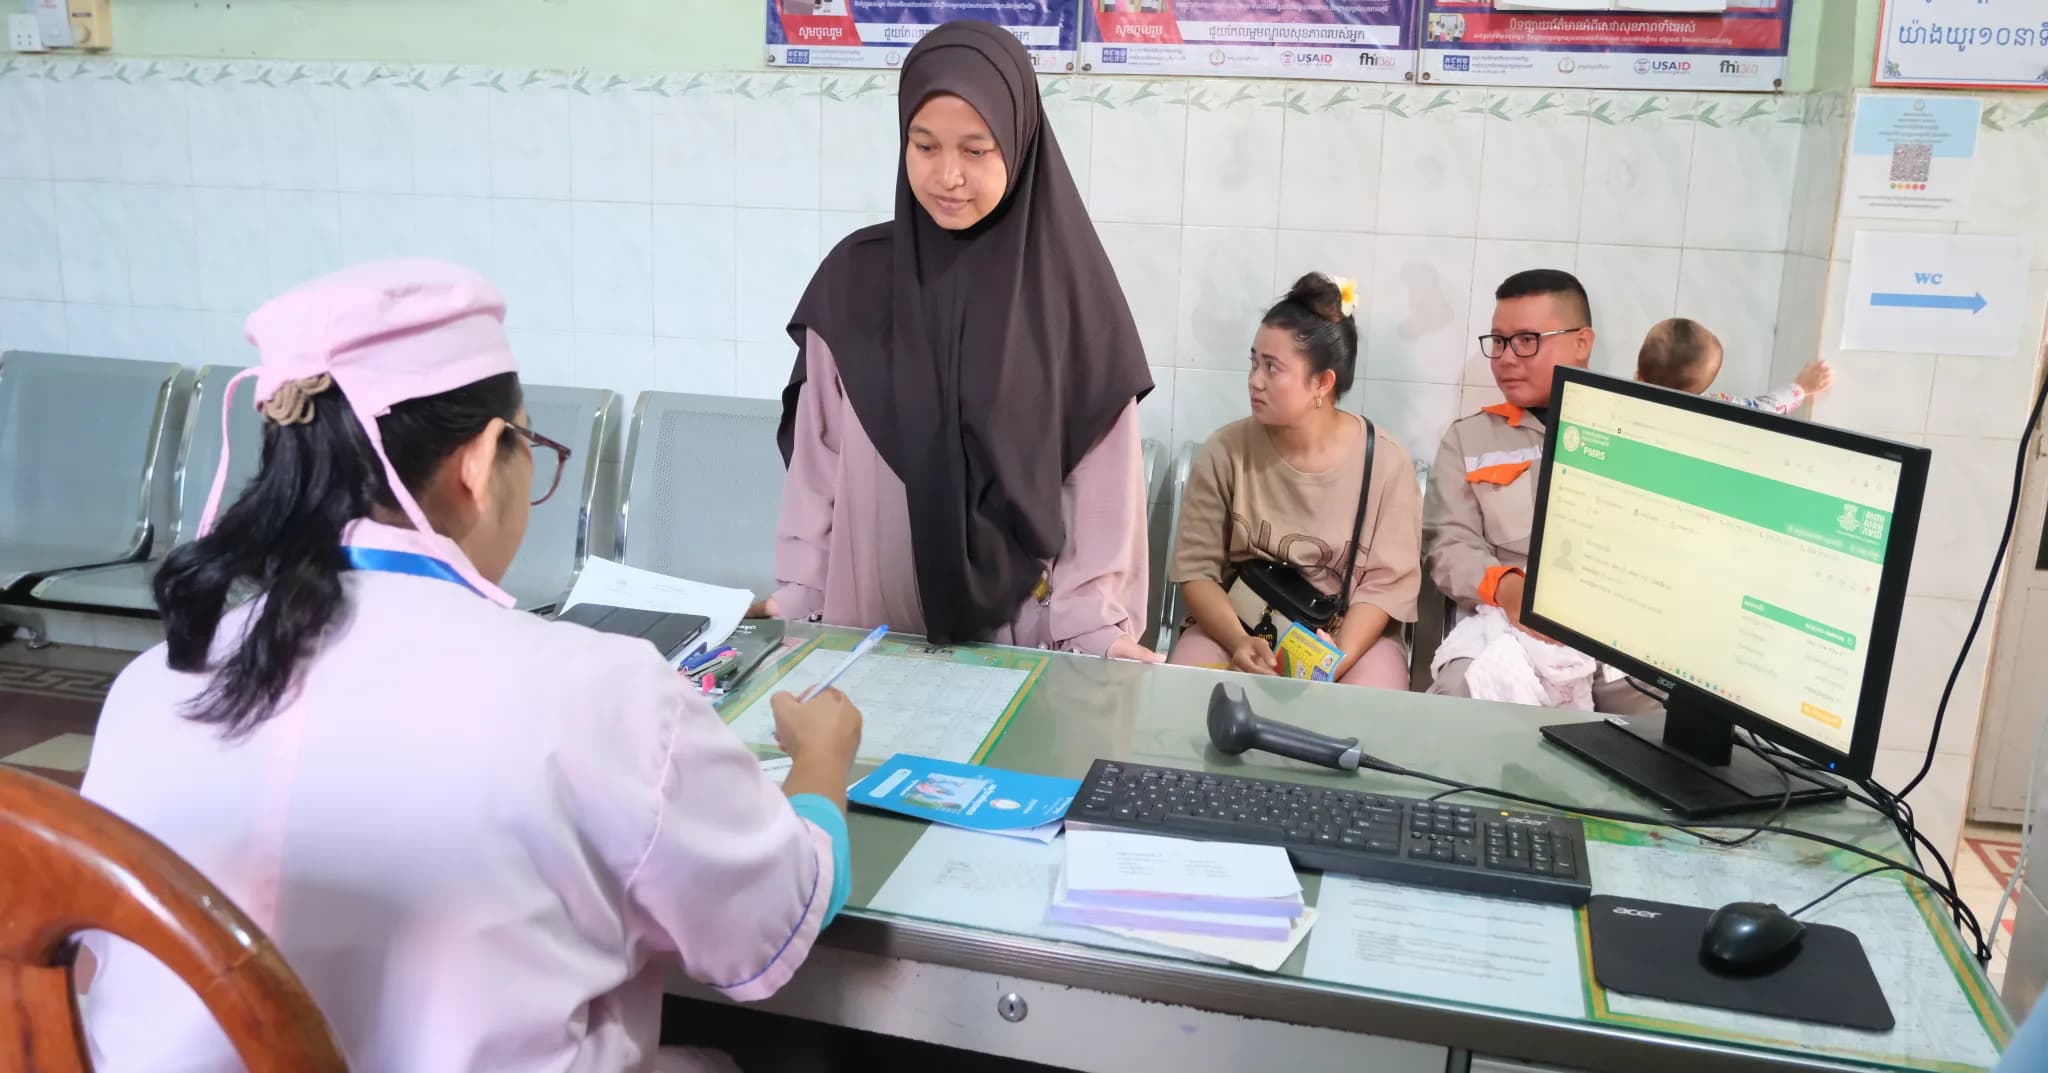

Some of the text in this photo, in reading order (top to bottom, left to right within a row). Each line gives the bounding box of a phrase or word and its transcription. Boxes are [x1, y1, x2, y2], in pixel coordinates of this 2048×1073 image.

[1297, 53, 1333, 64] USAID
[1652, 61, 1691, 71] USAID
[1914, 272, 1943, 285] WC
[1583, 446, 1606, 461] PMRS
[1656, 676, 1676, 689] acer
[1507, 817, 1548, 826] acer
[1612, 906, 1663, 918] acer
